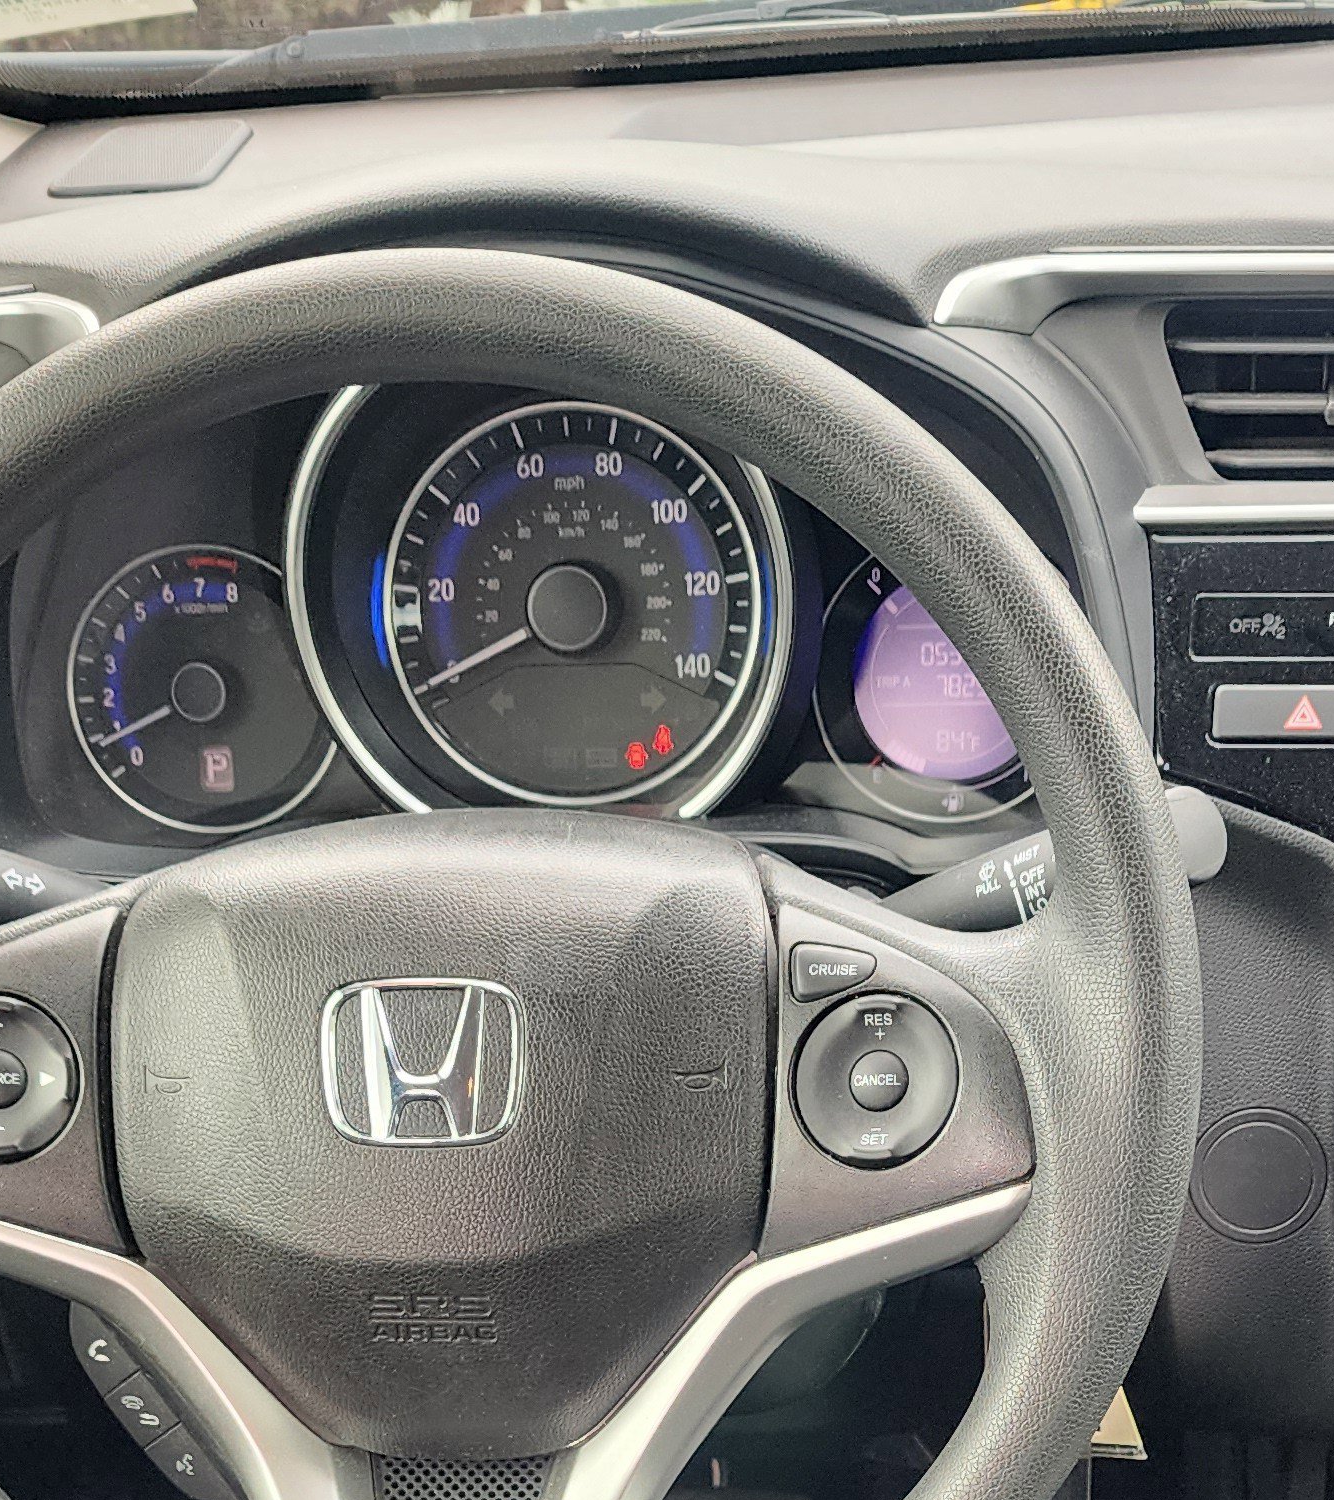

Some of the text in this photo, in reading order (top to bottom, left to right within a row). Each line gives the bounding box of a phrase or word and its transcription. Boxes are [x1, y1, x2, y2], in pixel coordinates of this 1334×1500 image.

[517, 453, 544, 479] 60
[595, 451, 622, 476] 80
[554, 475, 585, 491] mph
[454, 502, 480, 527] 40
[572, 509, 590, 522] 120
[651, 498, 687, 524] 100
[600, 517, 619, 531] 140
[162, 583, 175, 604] 6
[194, 577, 206, 598] 7
[226, 582, 239, 603] 8
[428, 577, 455, 602] 20
[684, 571, 720, 596] 120
[134, 601, 147, 622] 5
[646, 596, 666, 609] 200
[114, 623, 125, 643] 4
[640, 628, 661, 642] 220
[1229, 617, 1260, 634] OFF
[104, 654, 116, 675] 3
[675, 653, 711, 678] 140
[103, 687, 115, 708] 2
[130, 745, 144, 766] 0
[203, 751, 228, 784] P
[1013, 844, 1040, 866] MIST
[1019, 862, 1045, 886] OFF
[975, 878, 1002, 898] PULL
[1024, 879, 1046, 901] INT
[808, 963, 858, 976] CRUISE
[863, 1012, 893, 1026] RES
[853, 1074, 901, 1087] CANCEL
[860, 1133, 889, 1145] SET
[368, 1295, 493, 1317] SRS
[370, 1325, 498, 1343] AIRBAG
